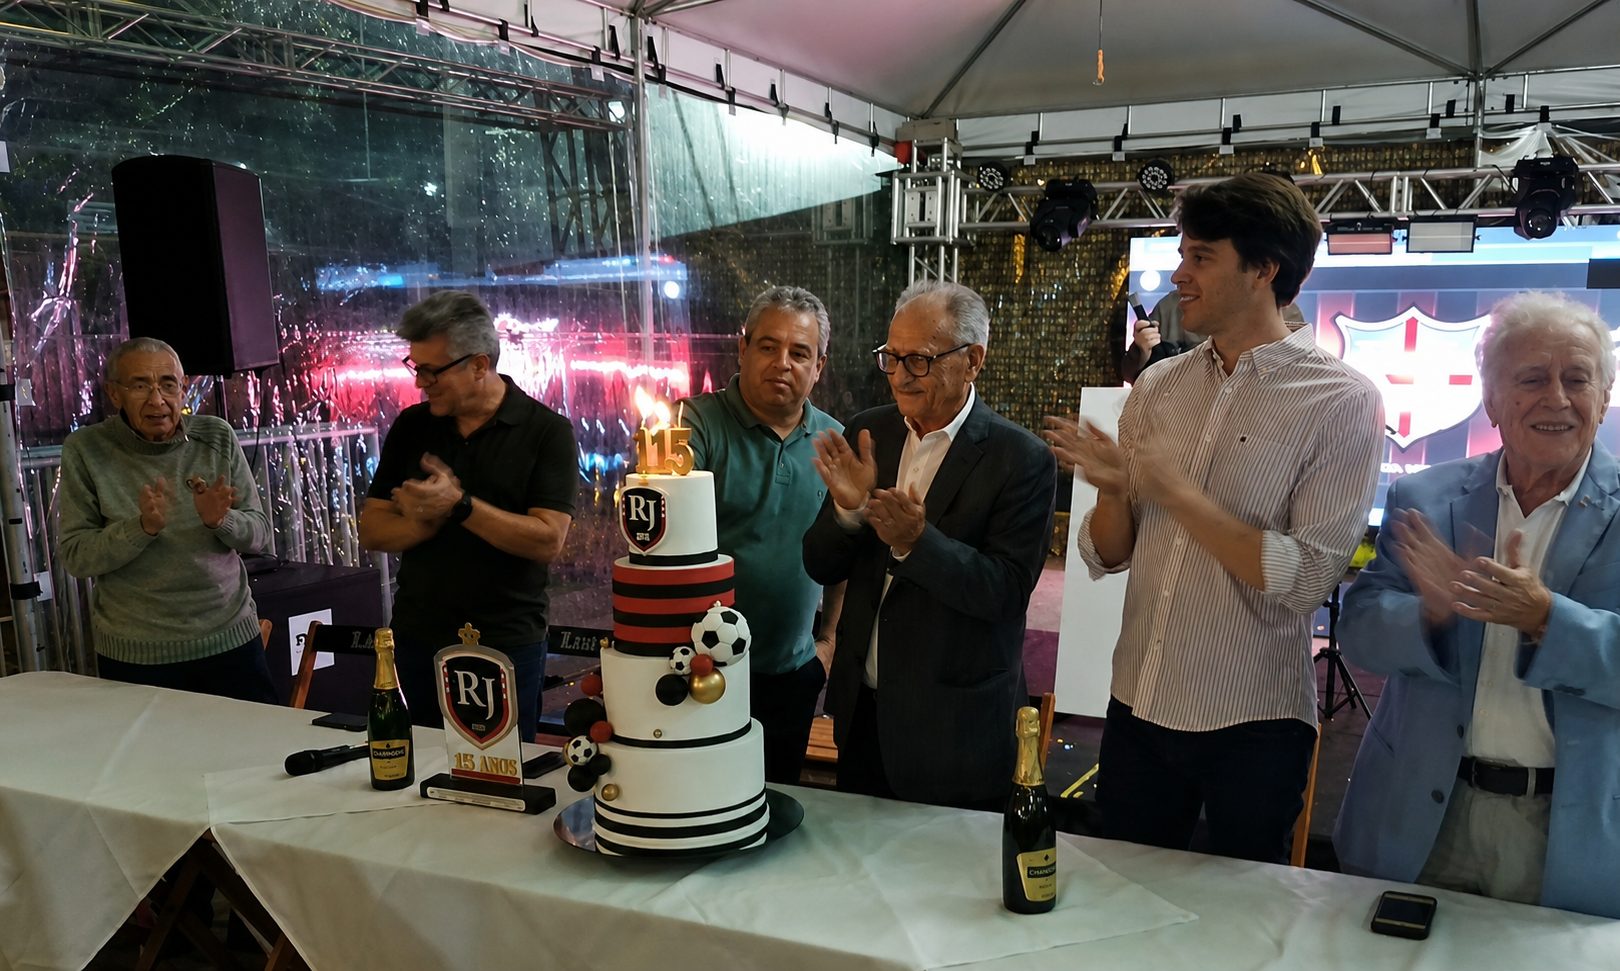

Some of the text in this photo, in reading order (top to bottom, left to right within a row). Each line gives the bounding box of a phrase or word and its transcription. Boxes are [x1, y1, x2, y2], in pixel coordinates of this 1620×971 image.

[634, 426, 695, 476] 115
[628, 494, 657, 532] RJ
[454, 669, 496, 720] RJ
[454, 752, 518, 777] 15 ANOS
